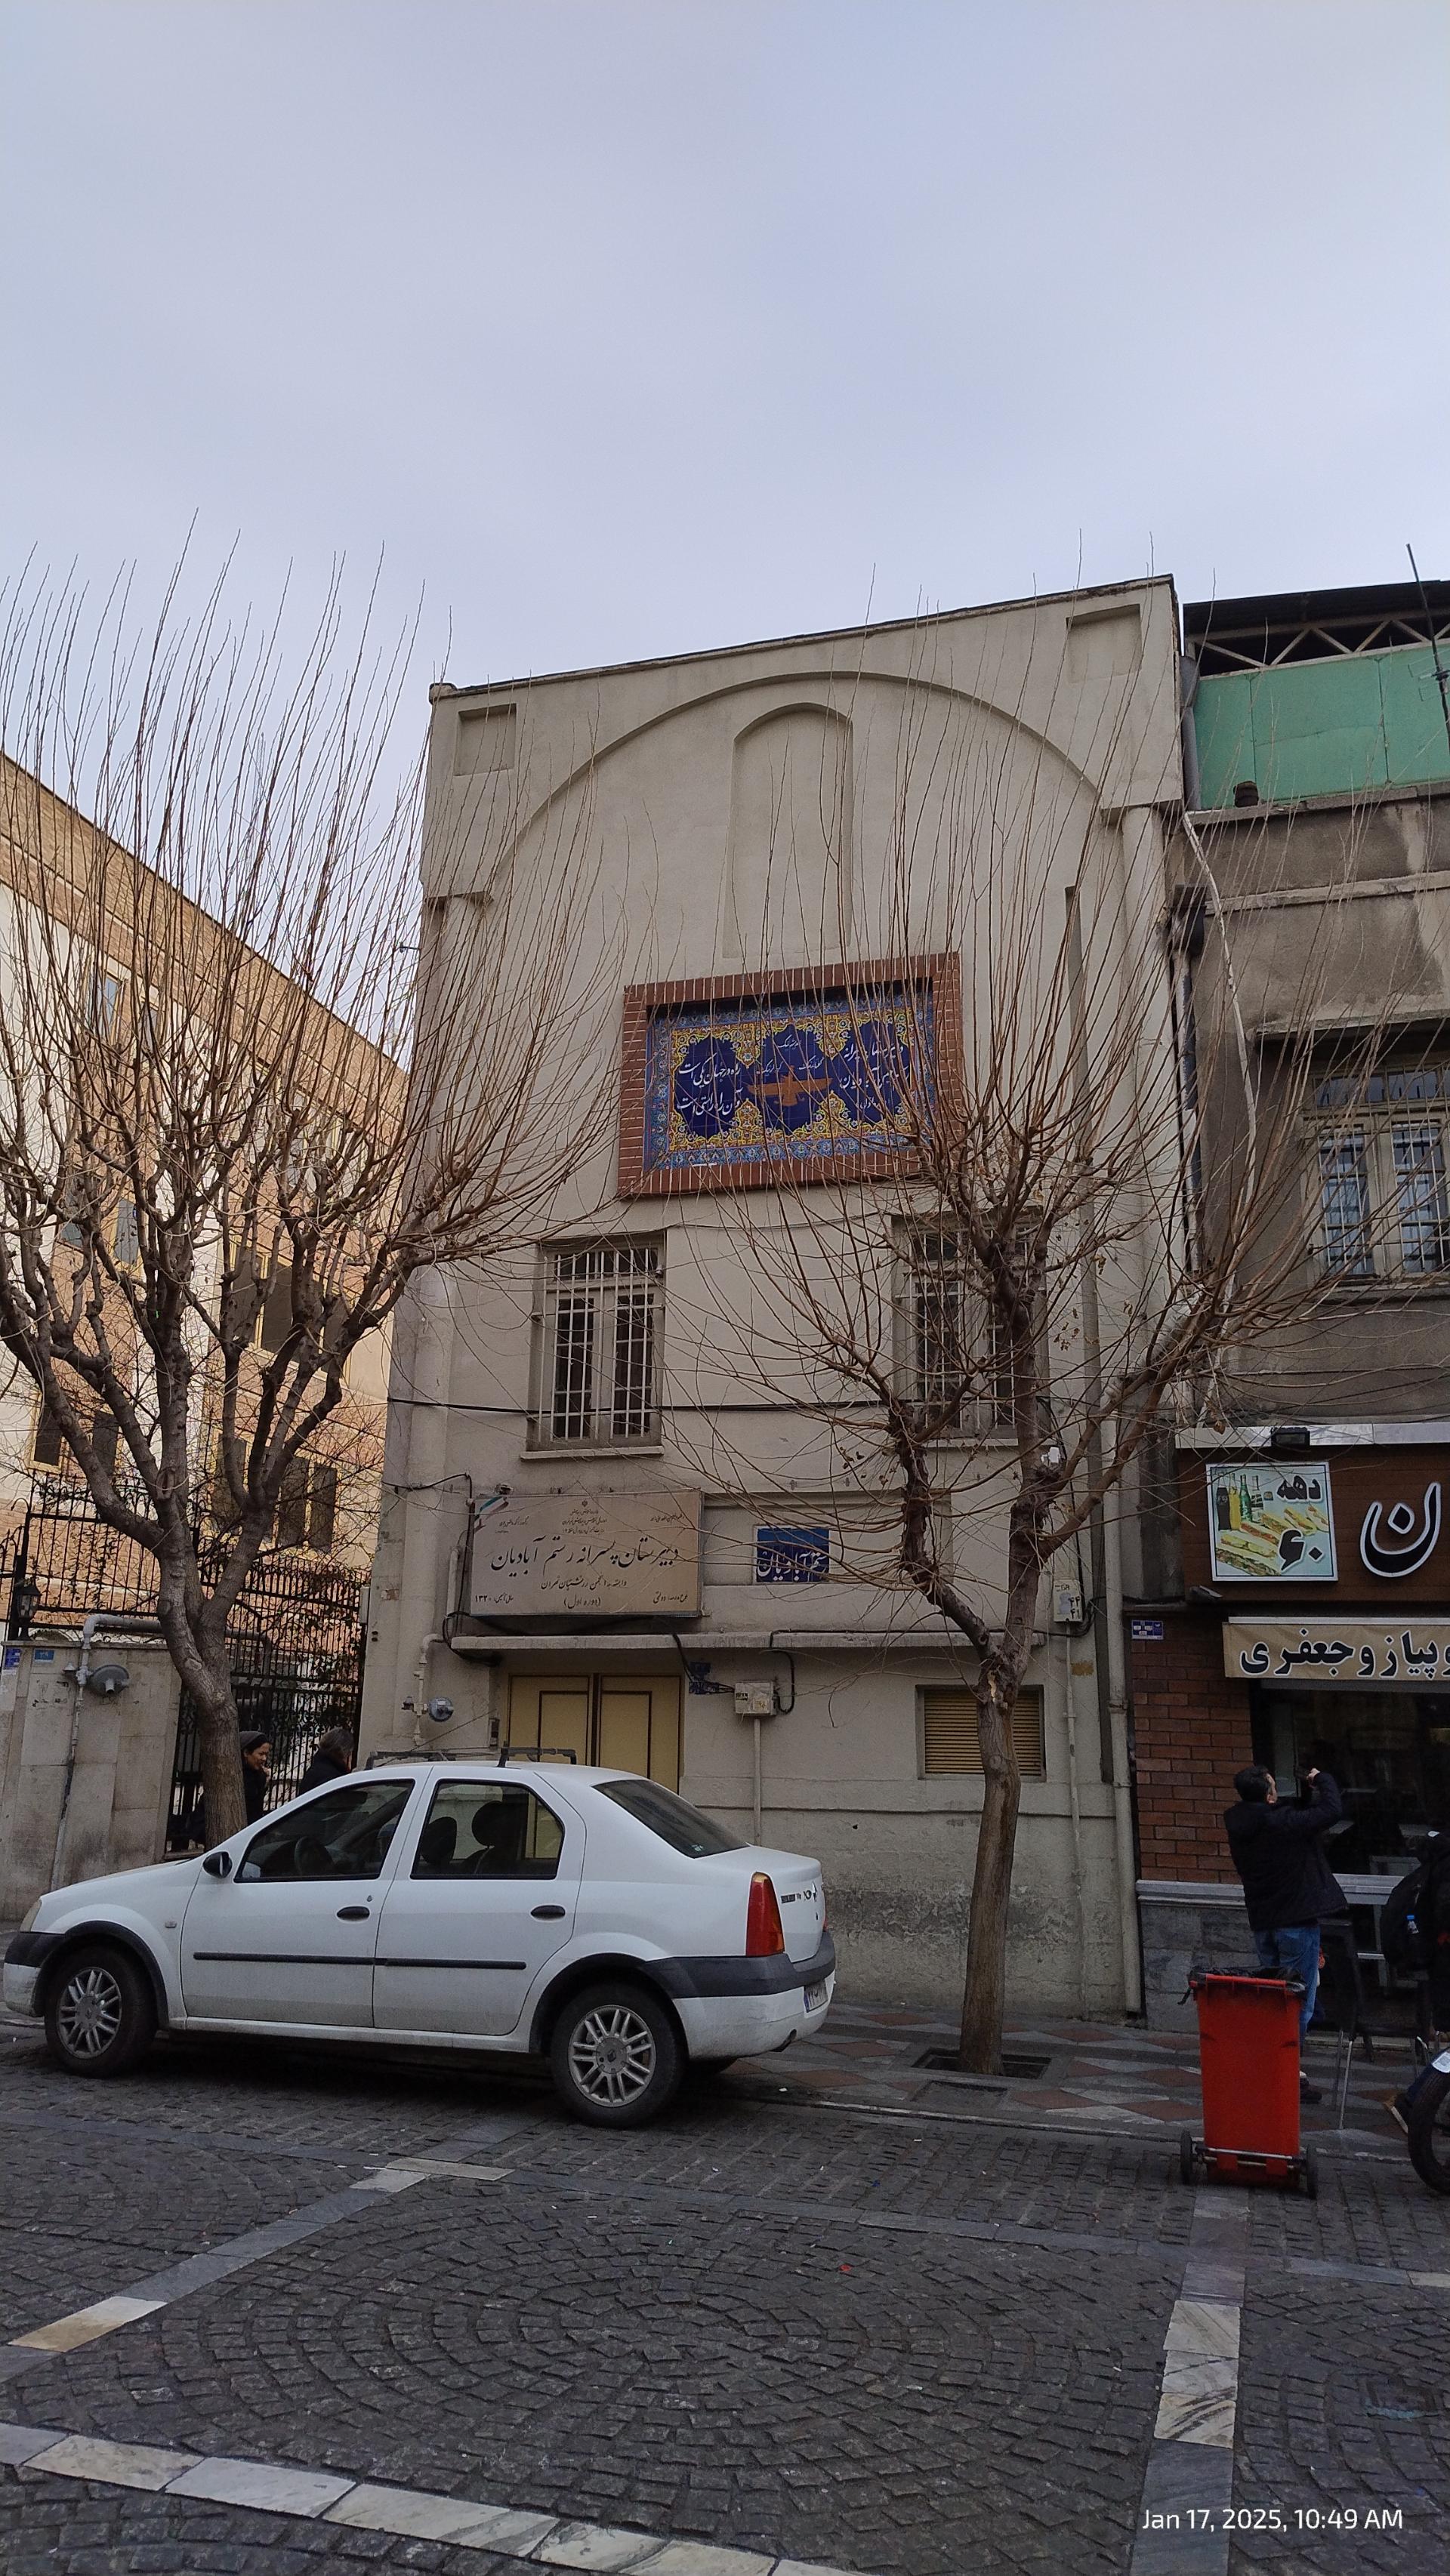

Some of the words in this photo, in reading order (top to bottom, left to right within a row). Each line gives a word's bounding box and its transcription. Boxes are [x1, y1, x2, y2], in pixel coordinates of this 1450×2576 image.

[1277, 1474, 1322, 1501] دهه
[491, 1534, 547, 1577] آبادیان
[541, 1536, 574, 1576] رستم
[576, 1539, 619, 1567] پسرانه
[617, 1536, 680, 1568] دبیرستان
[1241, 1628, 1355, 1675] جعفری
[1358, 1645, 1374, 1676] و
[1381, 1631, 1438, 1679] پیاز
